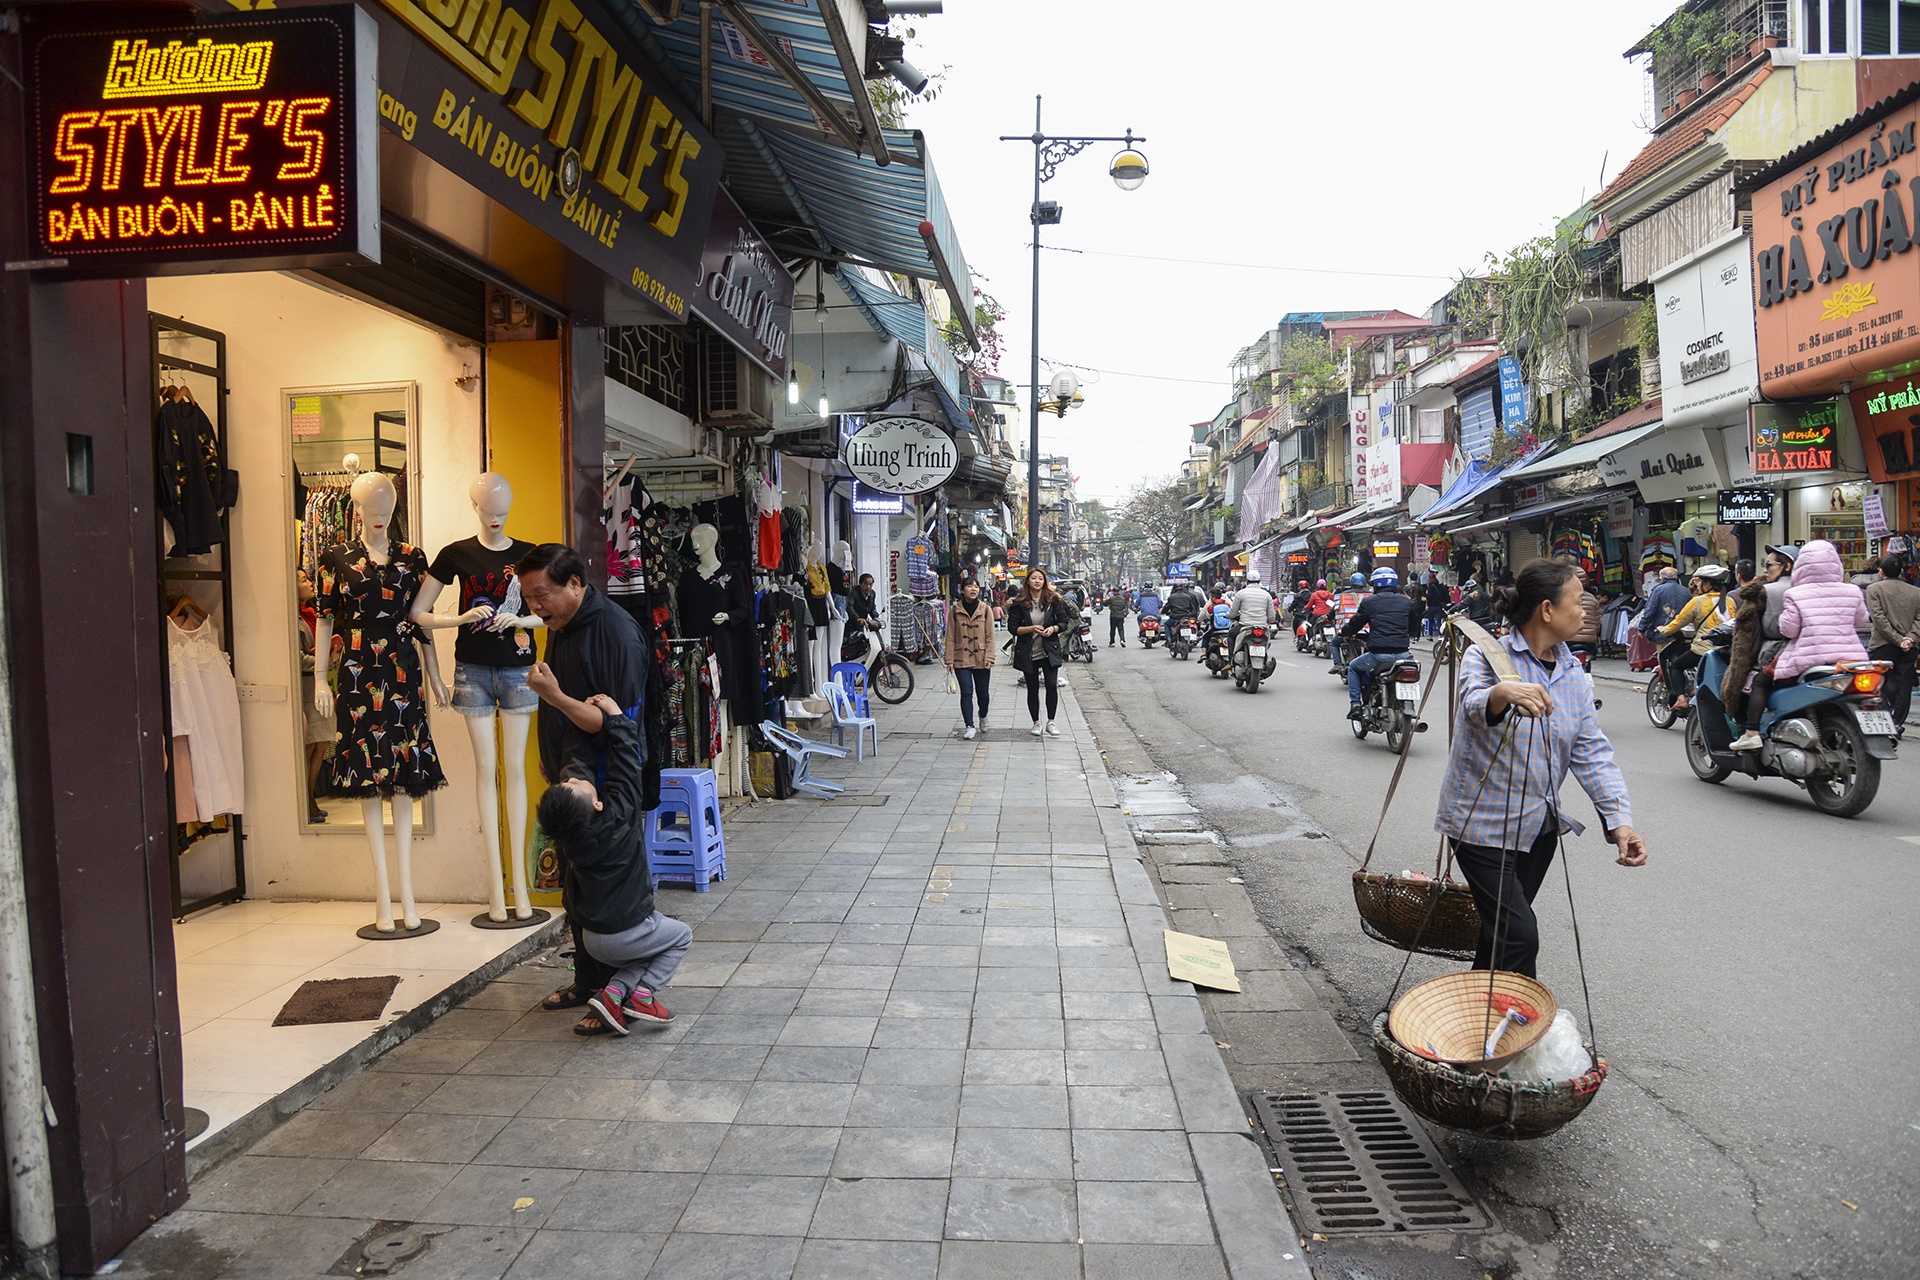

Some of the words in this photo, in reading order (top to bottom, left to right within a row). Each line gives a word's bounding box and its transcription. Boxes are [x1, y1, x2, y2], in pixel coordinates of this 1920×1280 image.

[50, 98, 330, 193] STYLE'S
[377, 88, 418, 141] ang
[432, 88, 493, 157] BÁN
[489, 131, 554, 202] BUÔN
[561, 188, 604, 237] BÁN
[598, 209, 621, 249] LẺ
[1781, 166, 1820, 217] MỸ
[1826, 122, 1917, 192] PHẨM
[49, 202, 110, 242] BÁN
[118, 196, 204, 237] BUÔN
[230, 192, 294, 231] BÁN
[632, 267, 650, 292] 098
[649, 279, 666, 303] 978
[665, 291, 684, 315] 4376
[1686, 331, 1723, 356] COSMETIC
[1809, 333, 1820, 349] 35
[1859, 333, 1877, 353] 114
[1503, 366, 1516, 375] NGA
[1504, 392, 1521, 404] KIM
[1866, 391, 1888, 415] MỸ
[852, 442, 900, 477] Hùng
[904, 442, 951, 469] Trinh
[1640, 459, 1666, 479] Mai
[1666, 452, 1705, 475] Quân
[1757, 448, 1782, 471] HÀ
[1783, 447, 1832, 470] XUÂN
[1865, 723, 1892, 733] 5179
